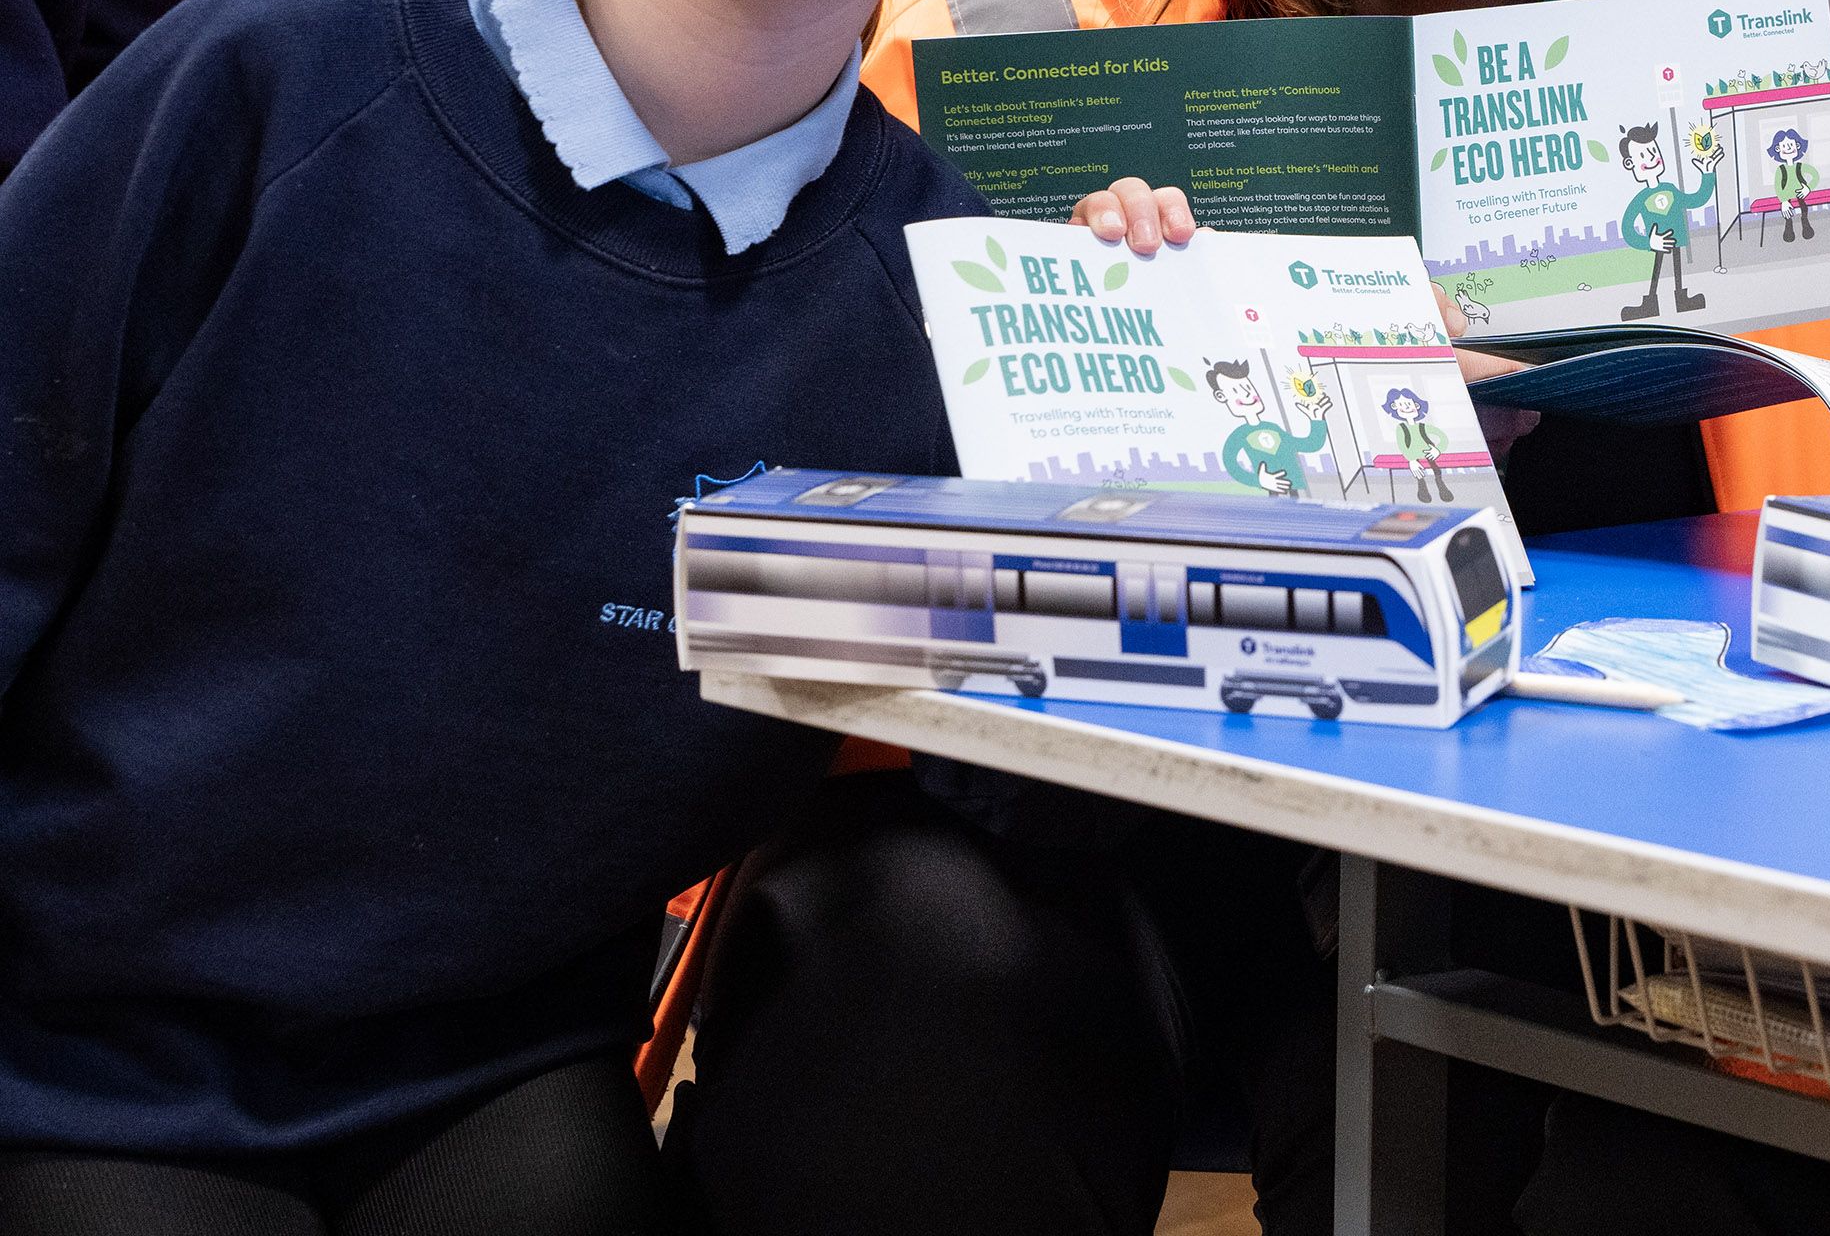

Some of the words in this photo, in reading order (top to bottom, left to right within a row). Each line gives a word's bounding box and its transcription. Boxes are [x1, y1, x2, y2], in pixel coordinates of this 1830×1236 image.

[1737, 8, 1813, 30] Translink
[1763, 28, 1794, 37] Connected
[941, 70, 999, 84] Better.
[1003, 62, 1099, 81] Connected
[1104, 60, 1129, 75] for
[1133, 57, 1170, 73] Kids
[1477, 43, 1513, 85] BE
[1518, 41, 1536, 80] A
[1184, 90, 1210, 100] After
[1213, 89, 1239, 99] that,
[1241, 86, 1277, 97] there's
[944, 104, 970, 114] Let's
[971, 103, 992, 113] talk
[994, 101, 1027, 112] about
[1029, 98, 1084, 110] Translink's
[1086, 95, 1122, 107] Better.
[1439, 83, 1588, 139] TRANSLINK
[945, 116, 1005, 127] Connected
[1006, 113, 1053, 126] Strategy
[1186, 118, 1206, 127] That
[1207, 118, 1234, 126] means
[1236, 117, 1264, 126] always
[1264, 115, 1294, 125] looking
[1295, 114, 1307, 123] for
[1308, 115, 1328, 124] ways
[1338, 114, 1359, 122] make
[1360, 113, 1382, 123] things
[959, 132, 974, 140] like
[982, 132, 1006, 141] super
[1006, 130, 1025, 138] cool
[1026, 128, 1045, 138] plan
[1047, 128, 1056, 136] to
[1057, 126, 1081, 136] make
[1082, 123, 1121, 134] travelling
[1122, 121, 1152, 131] around
[1187, 131, 1207, 139] even
[1237, 127, 1251, 136] like
[1252, 126, 1275, 136] faster
[1276, 125, 1299, 134] trains
[1310, 126, 1326, 134] new
[1327, 125, 1341, 134] bus
[1341, 126, 1364, 134] routes
[947, 143, 985, 153] Northern
[986, 141, 1015, 151] Ireland
[1017, 141, 1037, 149] even
[1038, 138, 1067, 148] better!
[1188, 141, 1206, 150] cool
[1207, 141, 1237, 151] places.
[1452, 140, 1506, 185] ECO
[1510, 130, 1583, 177] HERO
[964, 170, 984, 181] stly,
[986, 169, 1018, 178] we've
[1020, 167, 1039, 178] got
[1190, 168, 1214, 178] Last
[1216, 166, 1235, 176] but
[1236, 166, 1255, 175] not
[1256, 165, 1284, 175] least,
[1286, 164, 1321, 174] there's
[1360, 165, 1379, 174] and
[990, 196, 1016, 205] about
[1017, 194, 1048, 204] making
[1050, 194, 1067, 202] sure
[1192, 195, 1228, 204] Translink
[1229, 195, 1254, 203] knows
[1255, 194, 1273, 202] that
[1274, 193, 1310, 203] travelling
[1311, 193, 1326, 201] can
[1327, 192, 1338, 201] be
[1339, 192, 1351, 201] fun
[1352, 192, 1366, 201] and
[1367, 193, 1386, 202] good
[1456, 195, 1510, 211] Travelling
[1512, 190, 1537, 202] with
[1538, 183, 1588, 199] Translink
[1011, 207, 1032, 215] need
[1034, 206, 1043, 214] to
[1193, 208, 1206, 216] for
[1207, 208, 1221, 217] you
[1223, 206, 1240, 215] too!
[1240, 205, 1273, 215] Walking
[1284, 204, 1298, 212] the
[1299, 204, 1313, 212] bus
[1314, 204, 1331, 213] stop
[1341, 204, 1358, 212] train
[1359, 205, 1383, 213] station
[1468, 214, 1481, 225] to
[1484, 214, 1491, 222] a
[1494, 206, 1540, 221] Greener
[1542, 201, 1578, 215] Future
[1019, 255, 1068, 297] BE
[1070, 257, 1095, 297] A
[1321, 269, 1410, 286] Translink
[970, 304, 1164, 347] TRANSLINK
[999, 352, 1071, 397] ECO
[1074, 352, 1167, 394] HERO
[1011, 409, 1082, 423] Travelling
[1085, 408, 1114, 419] with
[1116, 407, 1175, 420] Translink
[1030, 428, 1047, 439] to
[1050, 427, 1060, 437] a
[1063, 424, 1120, 436] Greener
[1123, 423, 1166, 435] Future
[600, 602, 664, 631] STAR
